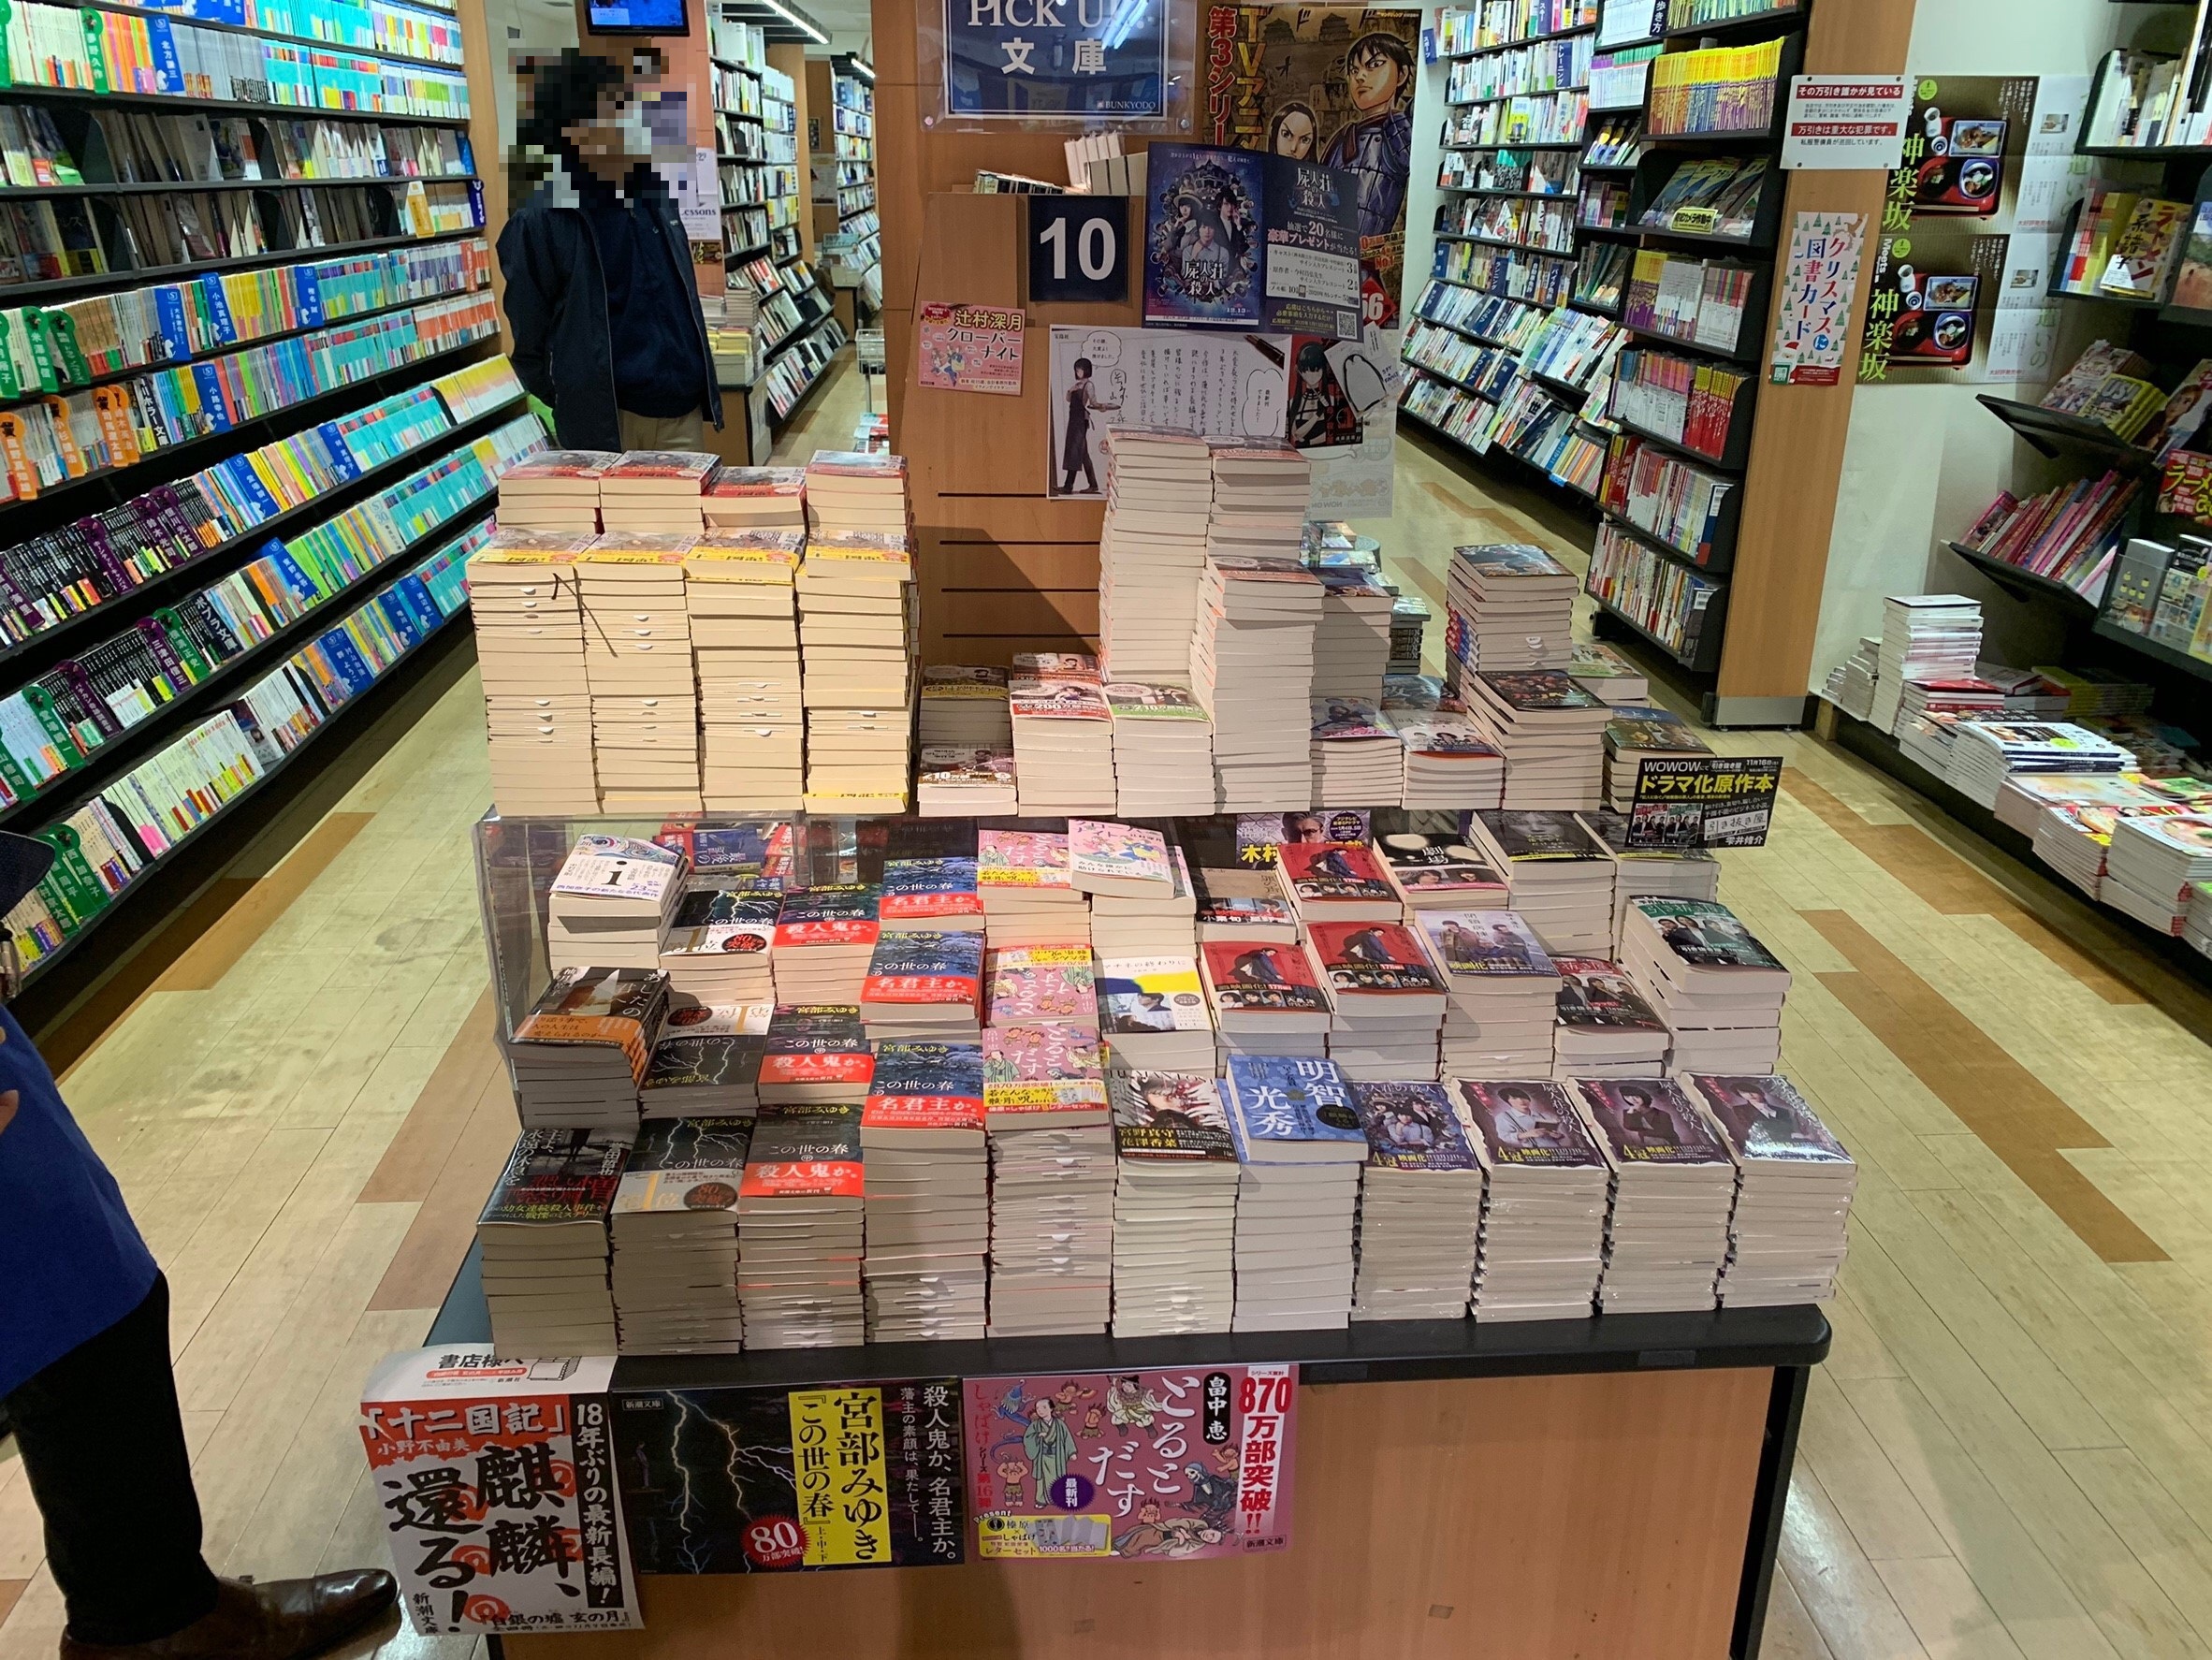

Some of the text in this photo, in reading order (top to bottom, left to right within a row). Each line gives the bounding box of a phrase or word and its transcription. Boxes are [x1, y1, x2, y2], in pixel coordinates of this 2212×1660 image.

[968, 0, 1066, 26] PICK
[1652, 0, 1666, 34] 歩き方
[1001, 37, 1106, 75] 文庫
[1423, 36, 1432, 58] スポーツ
[1798, 86, 1901, 95] その万引き誰かが見ている
[1105, 100, 1156, 109] BUNKYODO
[1798, 125, 1892, 135] 万引きは重大な犯罪です。
[1287, 221, 1344, 240] 抽選で20名様に
[1039, 217, 1116, 281] 10
[1268, 228, 1358, 256] 豪華プレゼントが当たる!
[1879, 238, 1893, 274] Meets
[1546, 269, 1559, 300] バイク免許
[1796, 238, 1827, 341] 図書カード
[1813, 238, 1846, 351] クリスマスに
[211, 292, 231, 335] 小池真理子
[955, 310, 1022, 331] 辻村深月
[947, 328, 1021, 344] クローバー
[1858, 288, 1899, 382] 神楽坂
[982, 345, 1019, 361] ナイト
[209, 386, 226, 421] 小路幸也
[55, 417, 78, 464] 小杉健治
[102, 410, 124, 460] 司馬遼太郎
[146, 517, 177, 558] 鈴木光司
[165, 506, 198, 552] 恒川光太郎
[195, 595, 239, 651] ポプラ文庫
[1640, 774, 1775, 794] ドラマ化原作本
[887, 859, 944, 867] 宮部みゆき
[808, 883, 866, 893] 宮部みゆき
[886, 881, 953, 891] この世の春
[892, 895, 976, 906] 名君主か。
[796, 909, 866, 918] この世の春
[872, 961, 948, 971] この世の春
[878, 977, 968, 989] 名君主か。
[796, 1006, 860, 1014] 宮部みゆき
[784, 1038, 859, 1048] この世の春
[882, 1043, 950, 1054] 宮部みゆき
[772, 1055, 867, 1069] 殺人鬼か。
[874, 1080, 954, 1091] この世の春
[1296, 1060, 1346, 1107] 明智
[782, 1105, 851, 1114] 宮部みゆき
[878, 1099, 978, 1112] 名君主か。
[1245, 1085, 1299, 1137] 光秀
[769, 1143, 849, 1155] この世の春
[755, 1164, 858, 1178] 殺人鬼か。
[625, 1399, 662, 1408] 新潮文庫
[1206, 1376, 1229, 1441] 畠中恵
[361, 1403, 564, 1438] 「十二国記」
[377, 1439, 471, 1455] 小野不由美
[797, 1394, 836, 1525] 『この世の春』
[834, 1391, 883, 1561] 宮部みゆき
[924, 1386, 956, 1561] 殺人鬼か、名君主か。
[1088, 1440, 1146, 1518] だす
[1065, 1477, 1078, 1507] 最新刊
[575, 1403, 617, 1604] 18年ぶりの最新長編!
[973, 1509, 1012, 1524] Present
[750, 1522, 798, 1553] 80
[1003, 1533, 1036, 1541] しゃばけ
[1245, 1536, 1286, 1550] 新潮文庫
[985, 1547, 1036, 1555] レターセット
[413, 1593, 439, 1634] 新潮文庫
